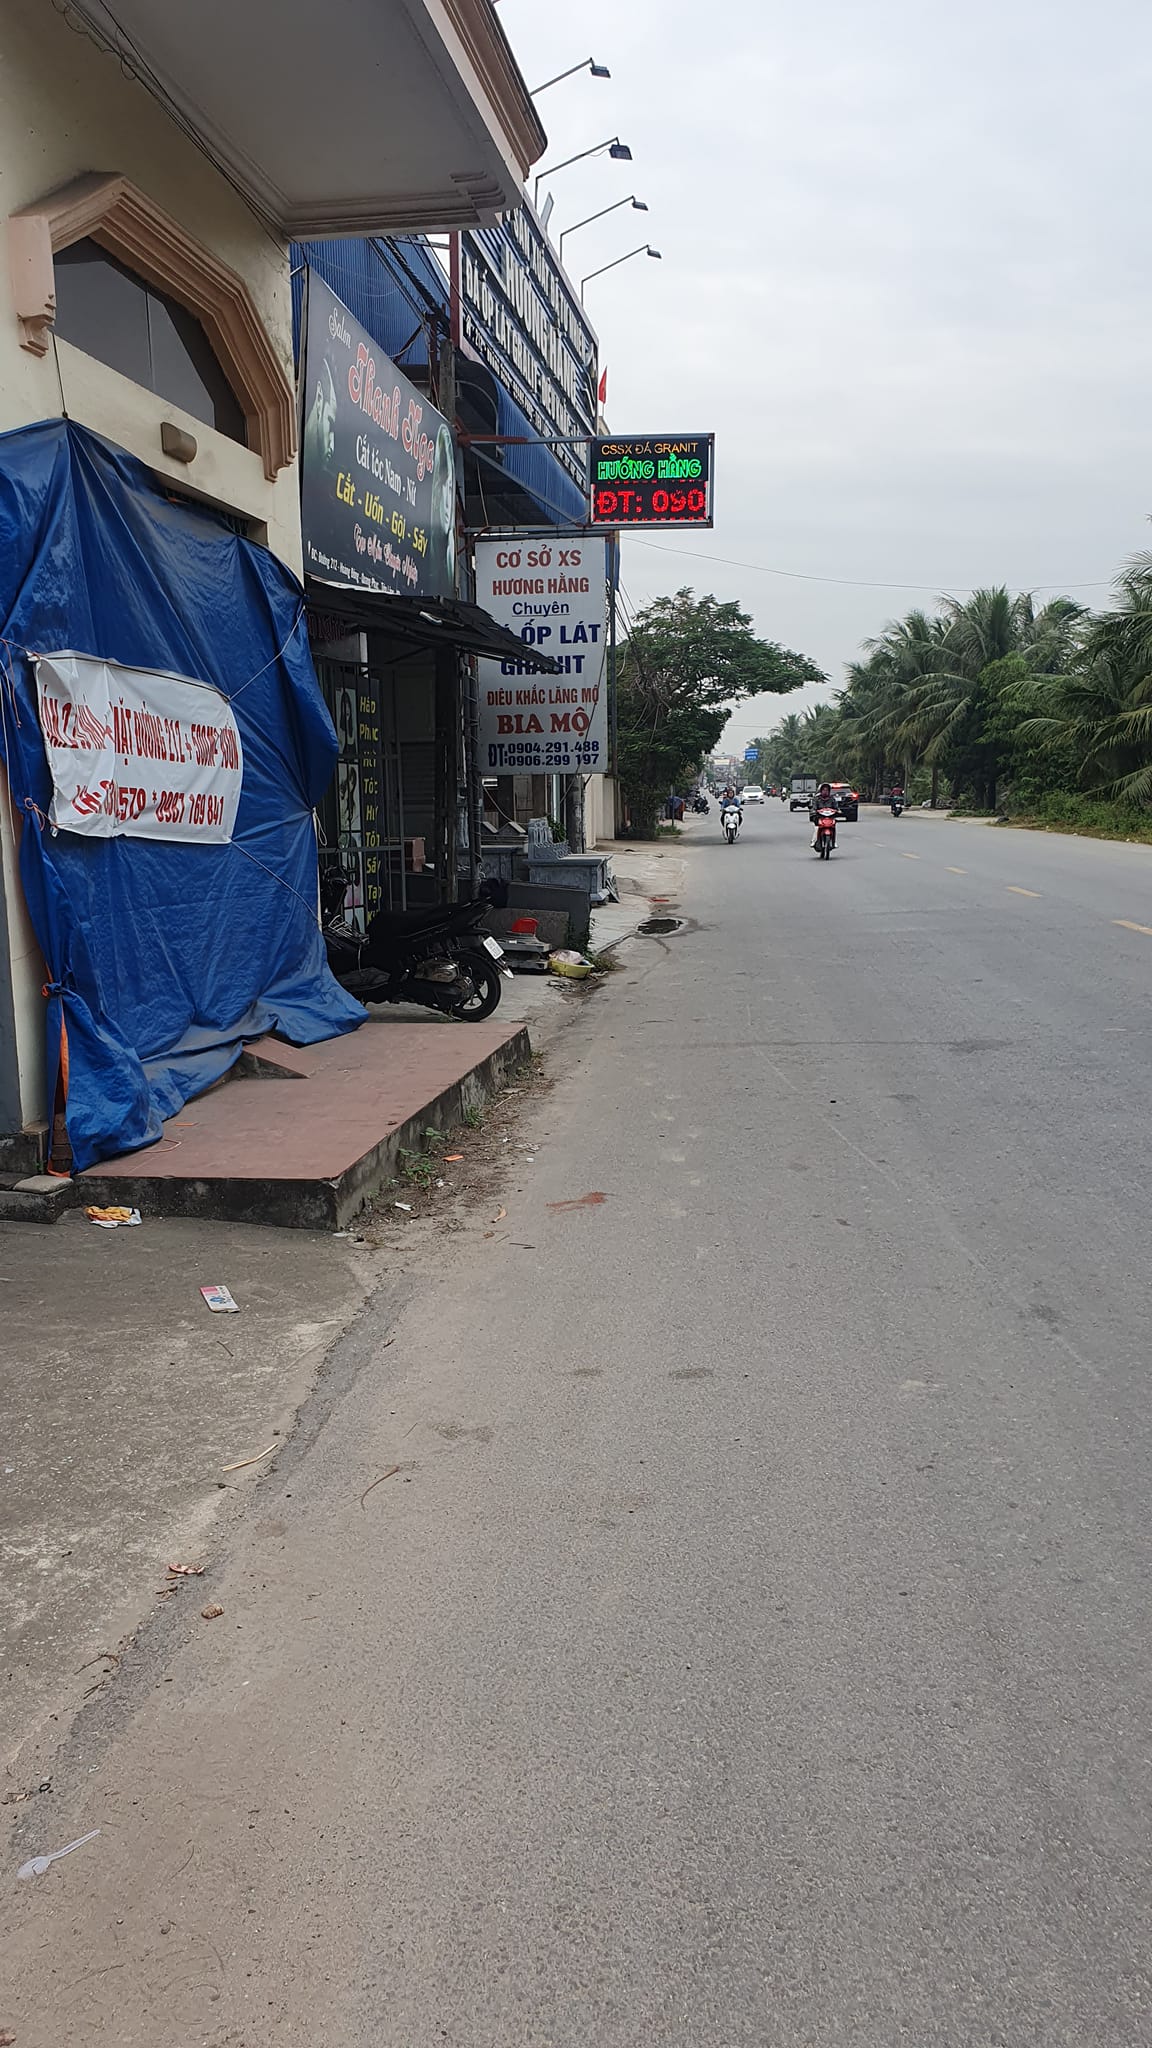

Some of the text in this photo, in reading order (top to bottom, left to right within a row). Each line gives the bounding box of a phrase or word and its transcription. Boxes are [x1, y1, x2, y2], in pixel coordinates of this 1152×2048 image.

[329, 307, 351, 349] Salon
[348, 342, 400, 440] Thanh
[356, 434, 370, 470] Cắt
[371, 447, 384, 481] tóc
[601, 441, 698, 455] CSSX ĐÁ GRANIT
[336, 472, 355, 507] Cắt
[365, 491, 384, 525] Uốn
[597, 490, 642, 514] ĐT:
[496, 544, 582, 568] CƠ SỞ XS
[492, 572, 589, 596] HƯƠNG HẰNG
[512, 601, 570, 618] Chuyên
[521, 618, 601, 645] ỐP LÁT
[501, 655, 585, 675] GIT
[516, 684, 545, 705] KHẮC
[549, 685, 578, 704] LĂNG
[581, 684, 599, 706] MỘ
[496, 706, 590, 737] BIA MỘ
[508, 741, 600, 754] 0904.291.488
